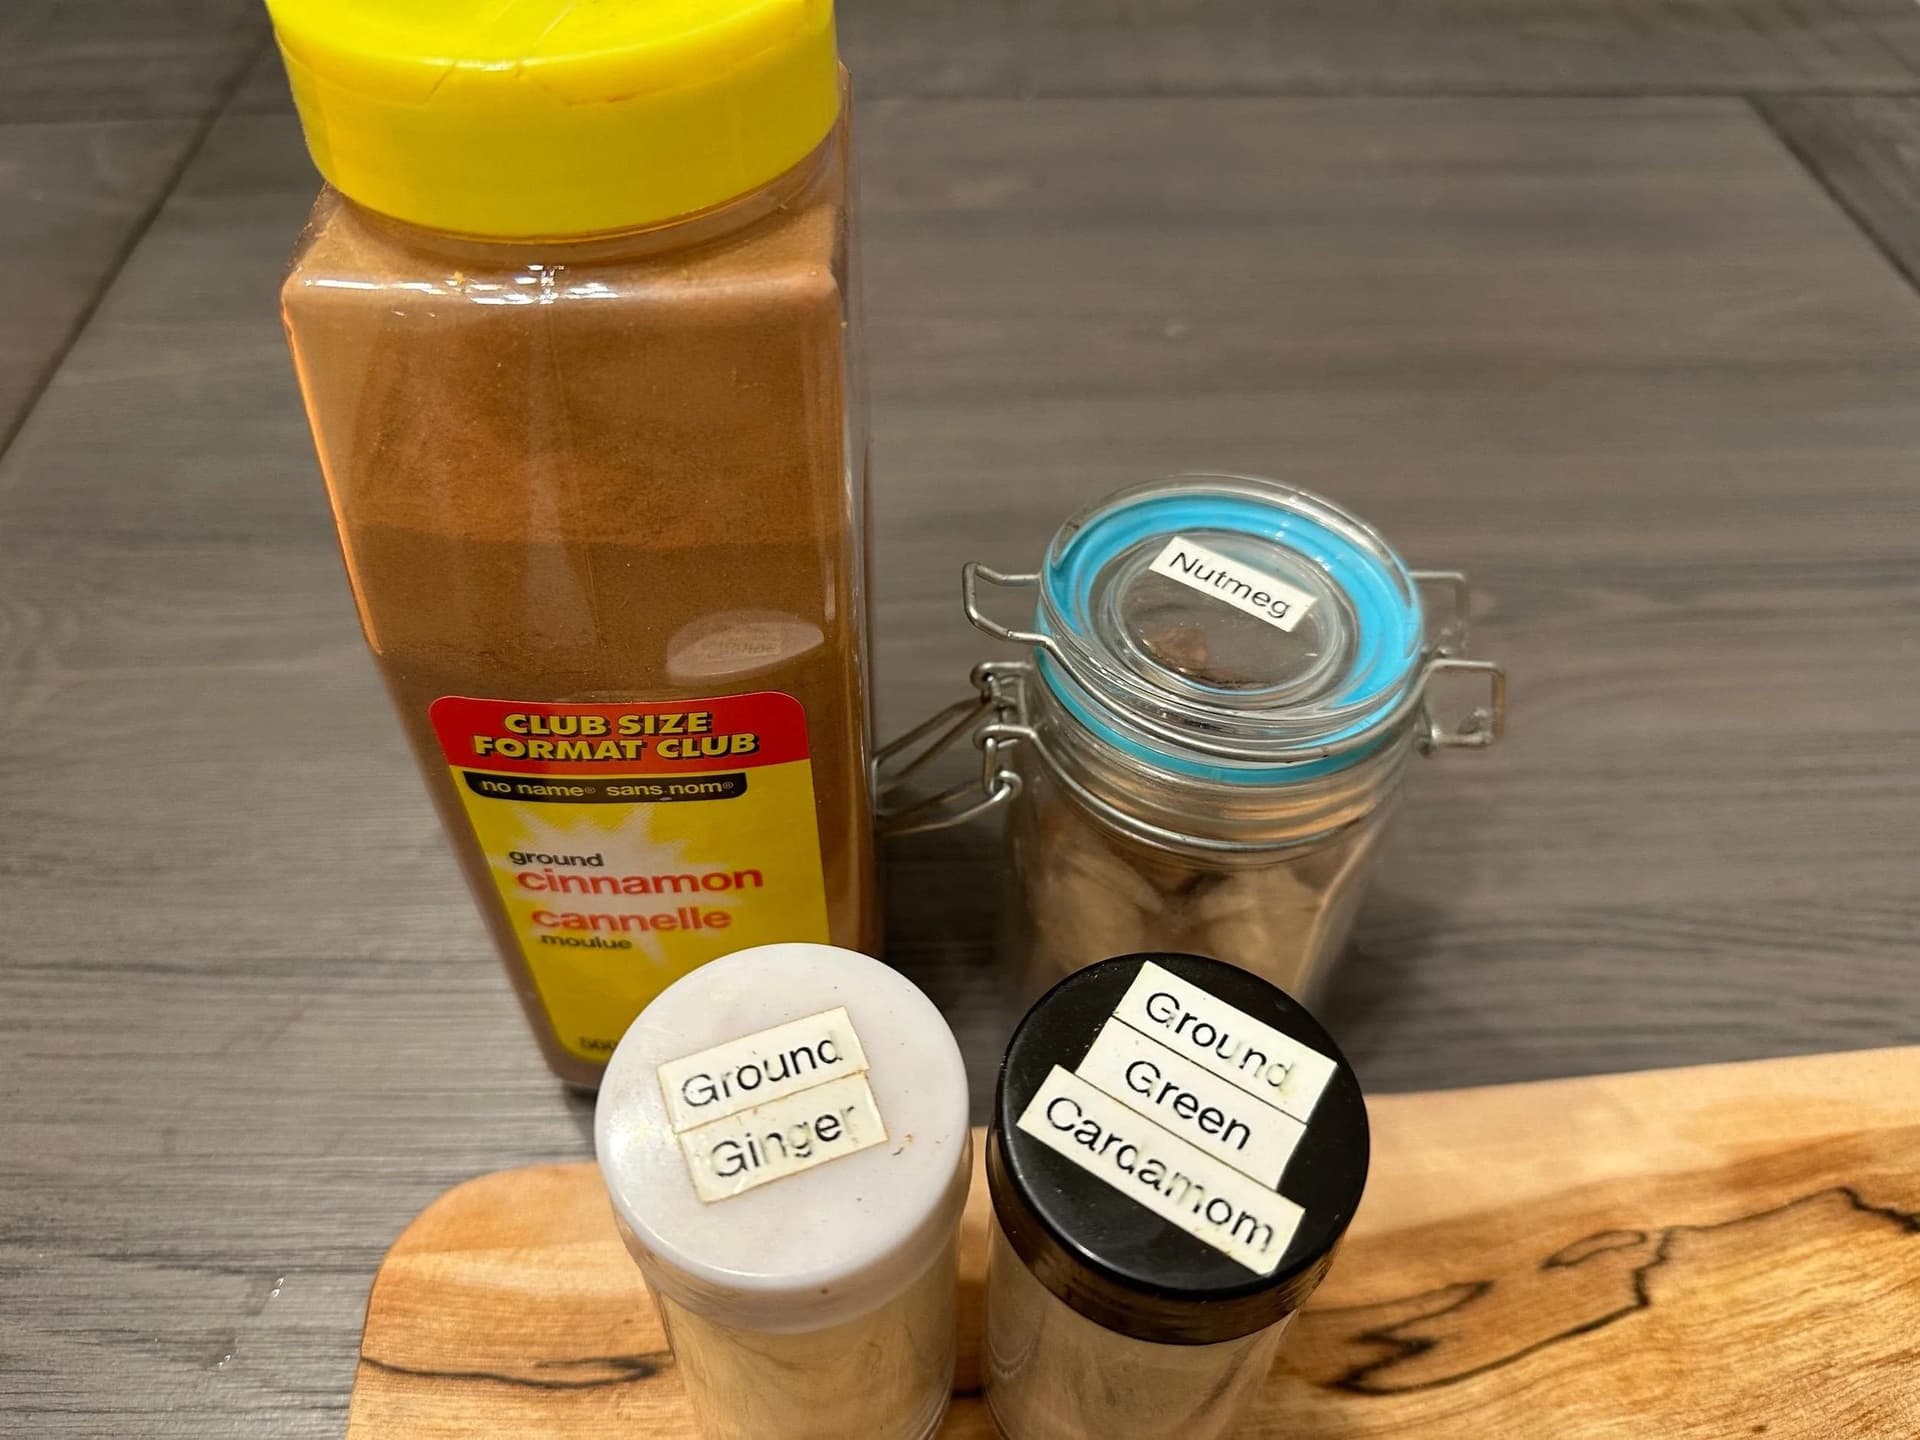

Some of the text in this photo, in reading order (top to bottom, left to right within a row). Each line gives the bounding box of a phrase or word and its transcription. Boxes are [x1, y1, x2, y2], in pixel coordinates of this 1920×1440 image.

[1168, 551, 1292, 620] Nutmeg
[505, 711, 713, 737] CLUB SIZE
[474, 733, 760, 762] FORMAT CLUB
[482, 780, 512, 795] no
[606, 784, 663, 797] sans
[508, 851, 604, 868] ground
[517, 868, 764, 895] cinnamon
[531, 907, 732, 933] cannelle
[540, 935, 633, 951] moulue
[1145, 992, 1295, 1089] Ground
[1125, 1060, 1251, 1151] Green
[710, 1105, 856, 1179] Ginger
